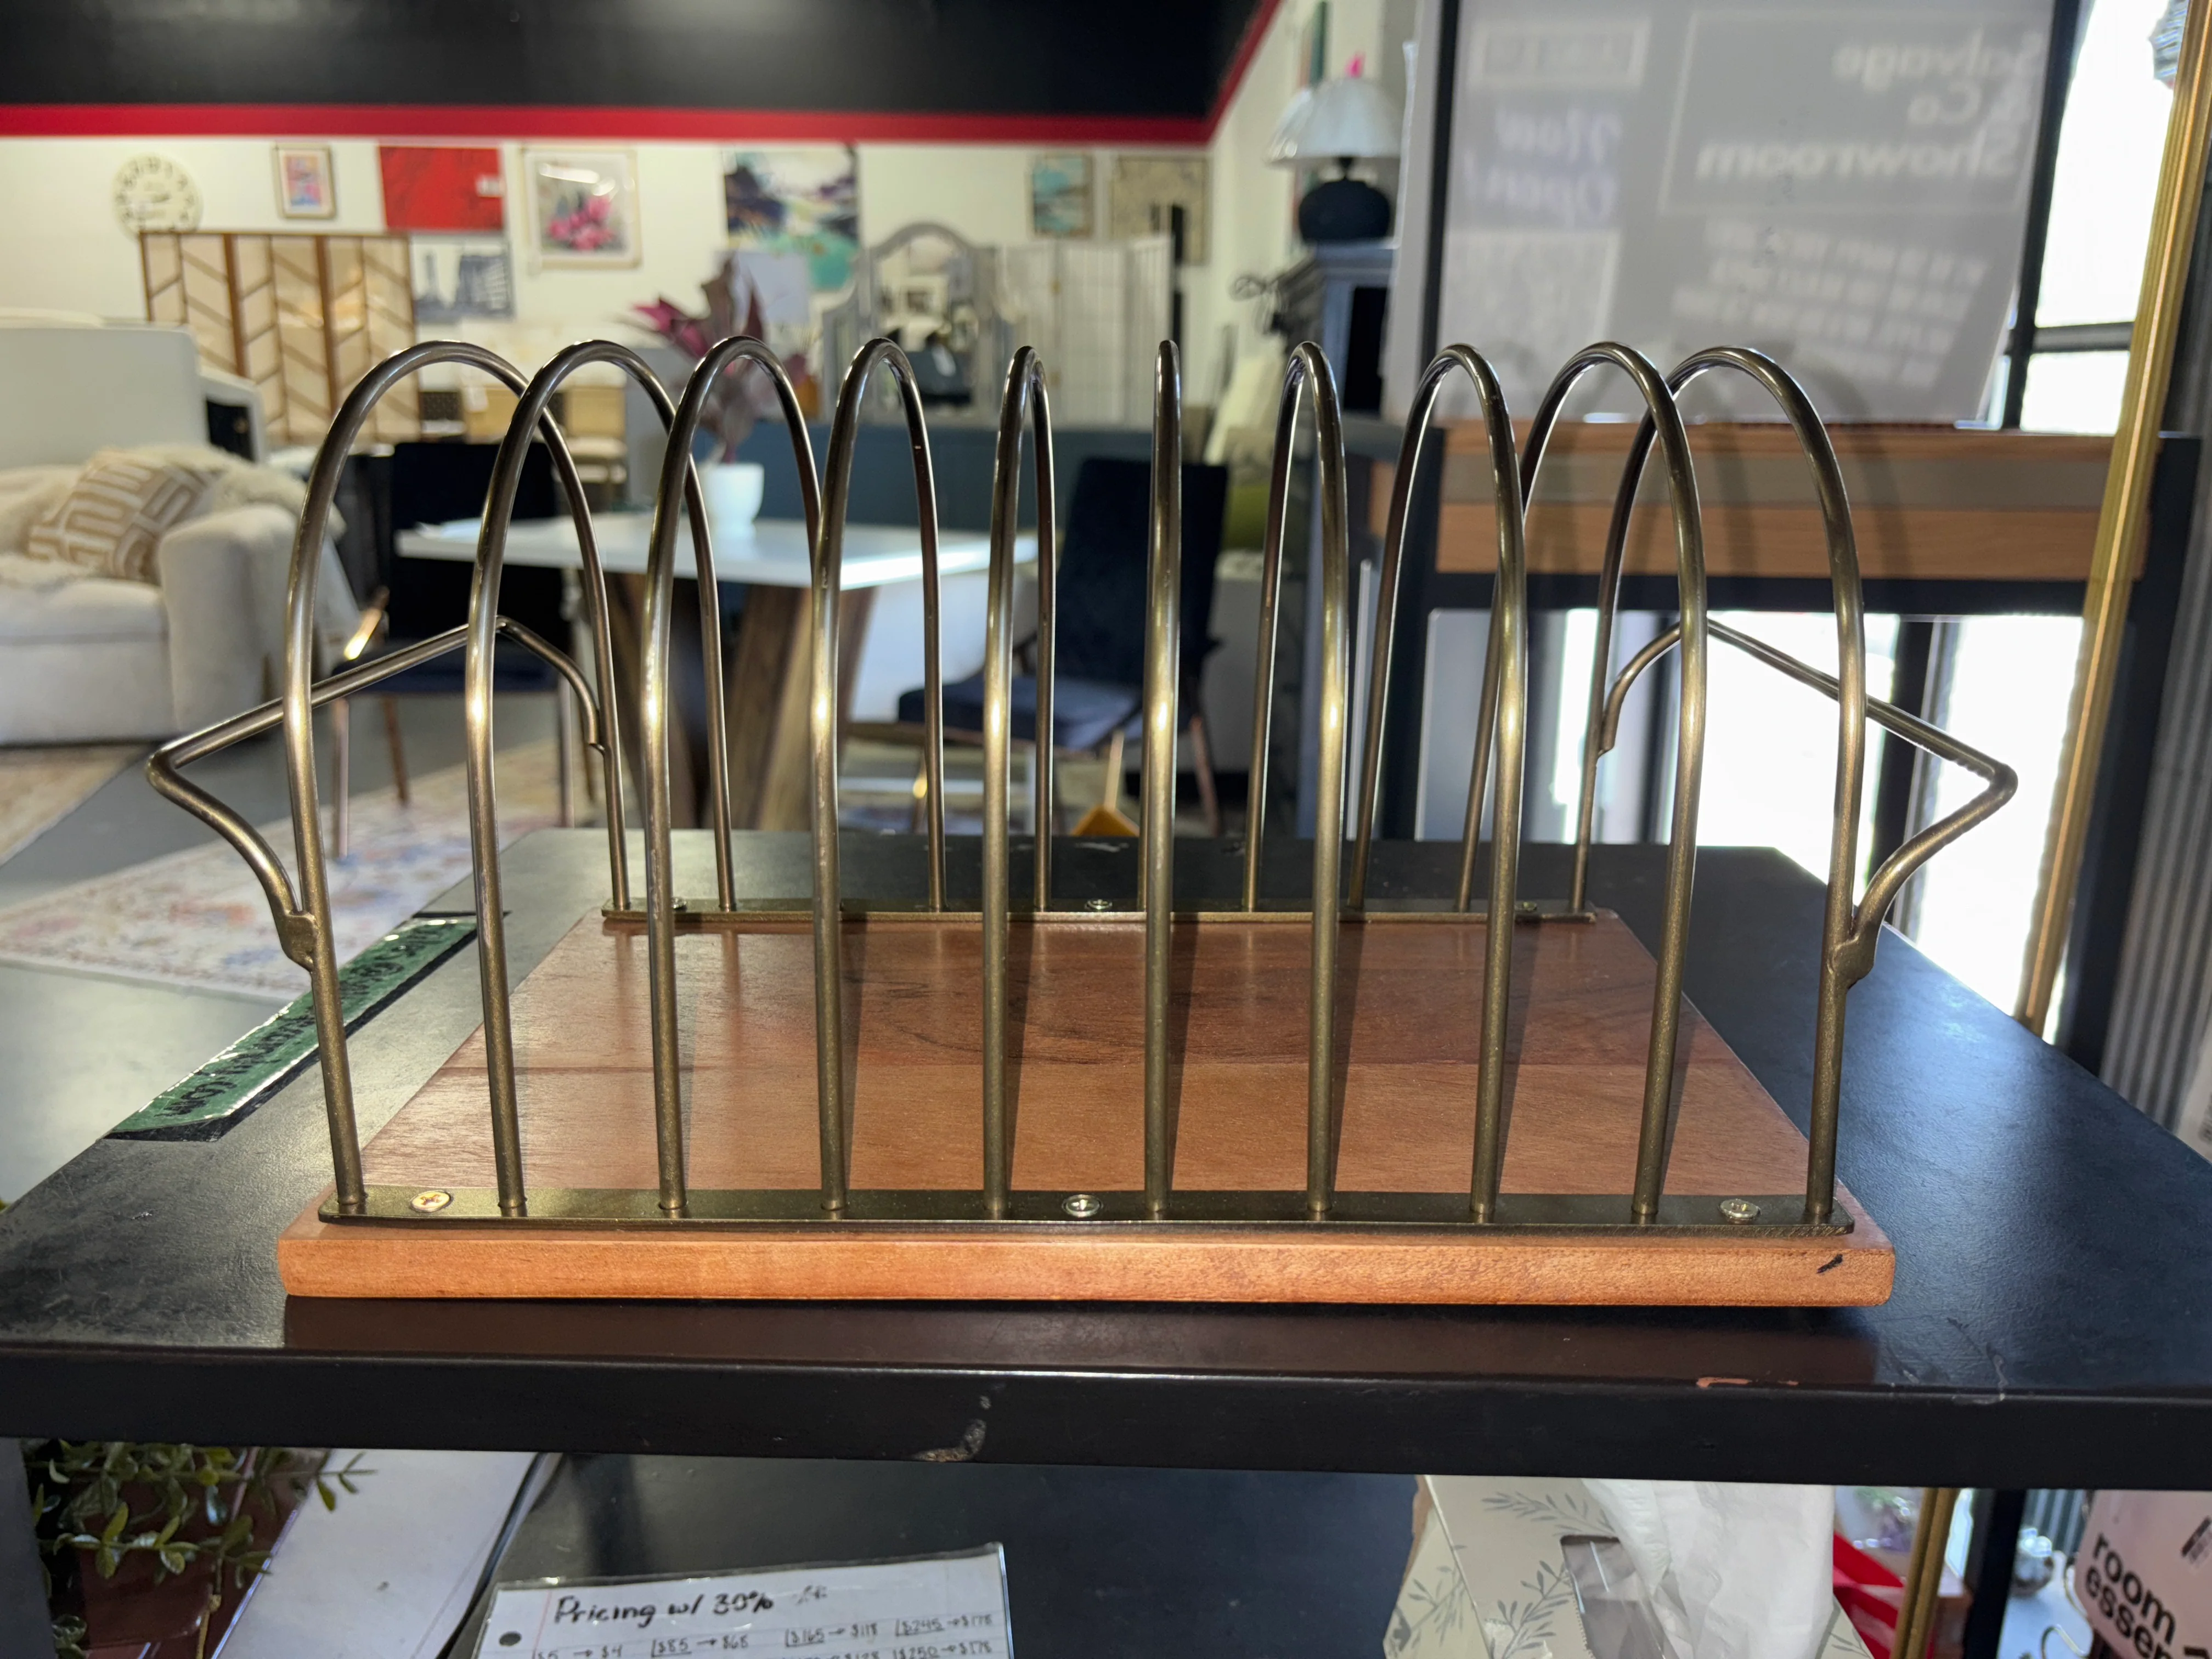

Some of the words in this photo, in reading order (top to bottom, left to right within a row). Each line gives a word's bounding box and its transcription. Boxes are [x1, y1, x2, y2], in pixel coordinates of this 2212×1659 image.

[554, 1595, 656, 1628] Pricing
[668, 1594, 704, 1615] w/
[713, 1591, 774, 1614] 30%
[2093, 1533, 2176, 1645] room
